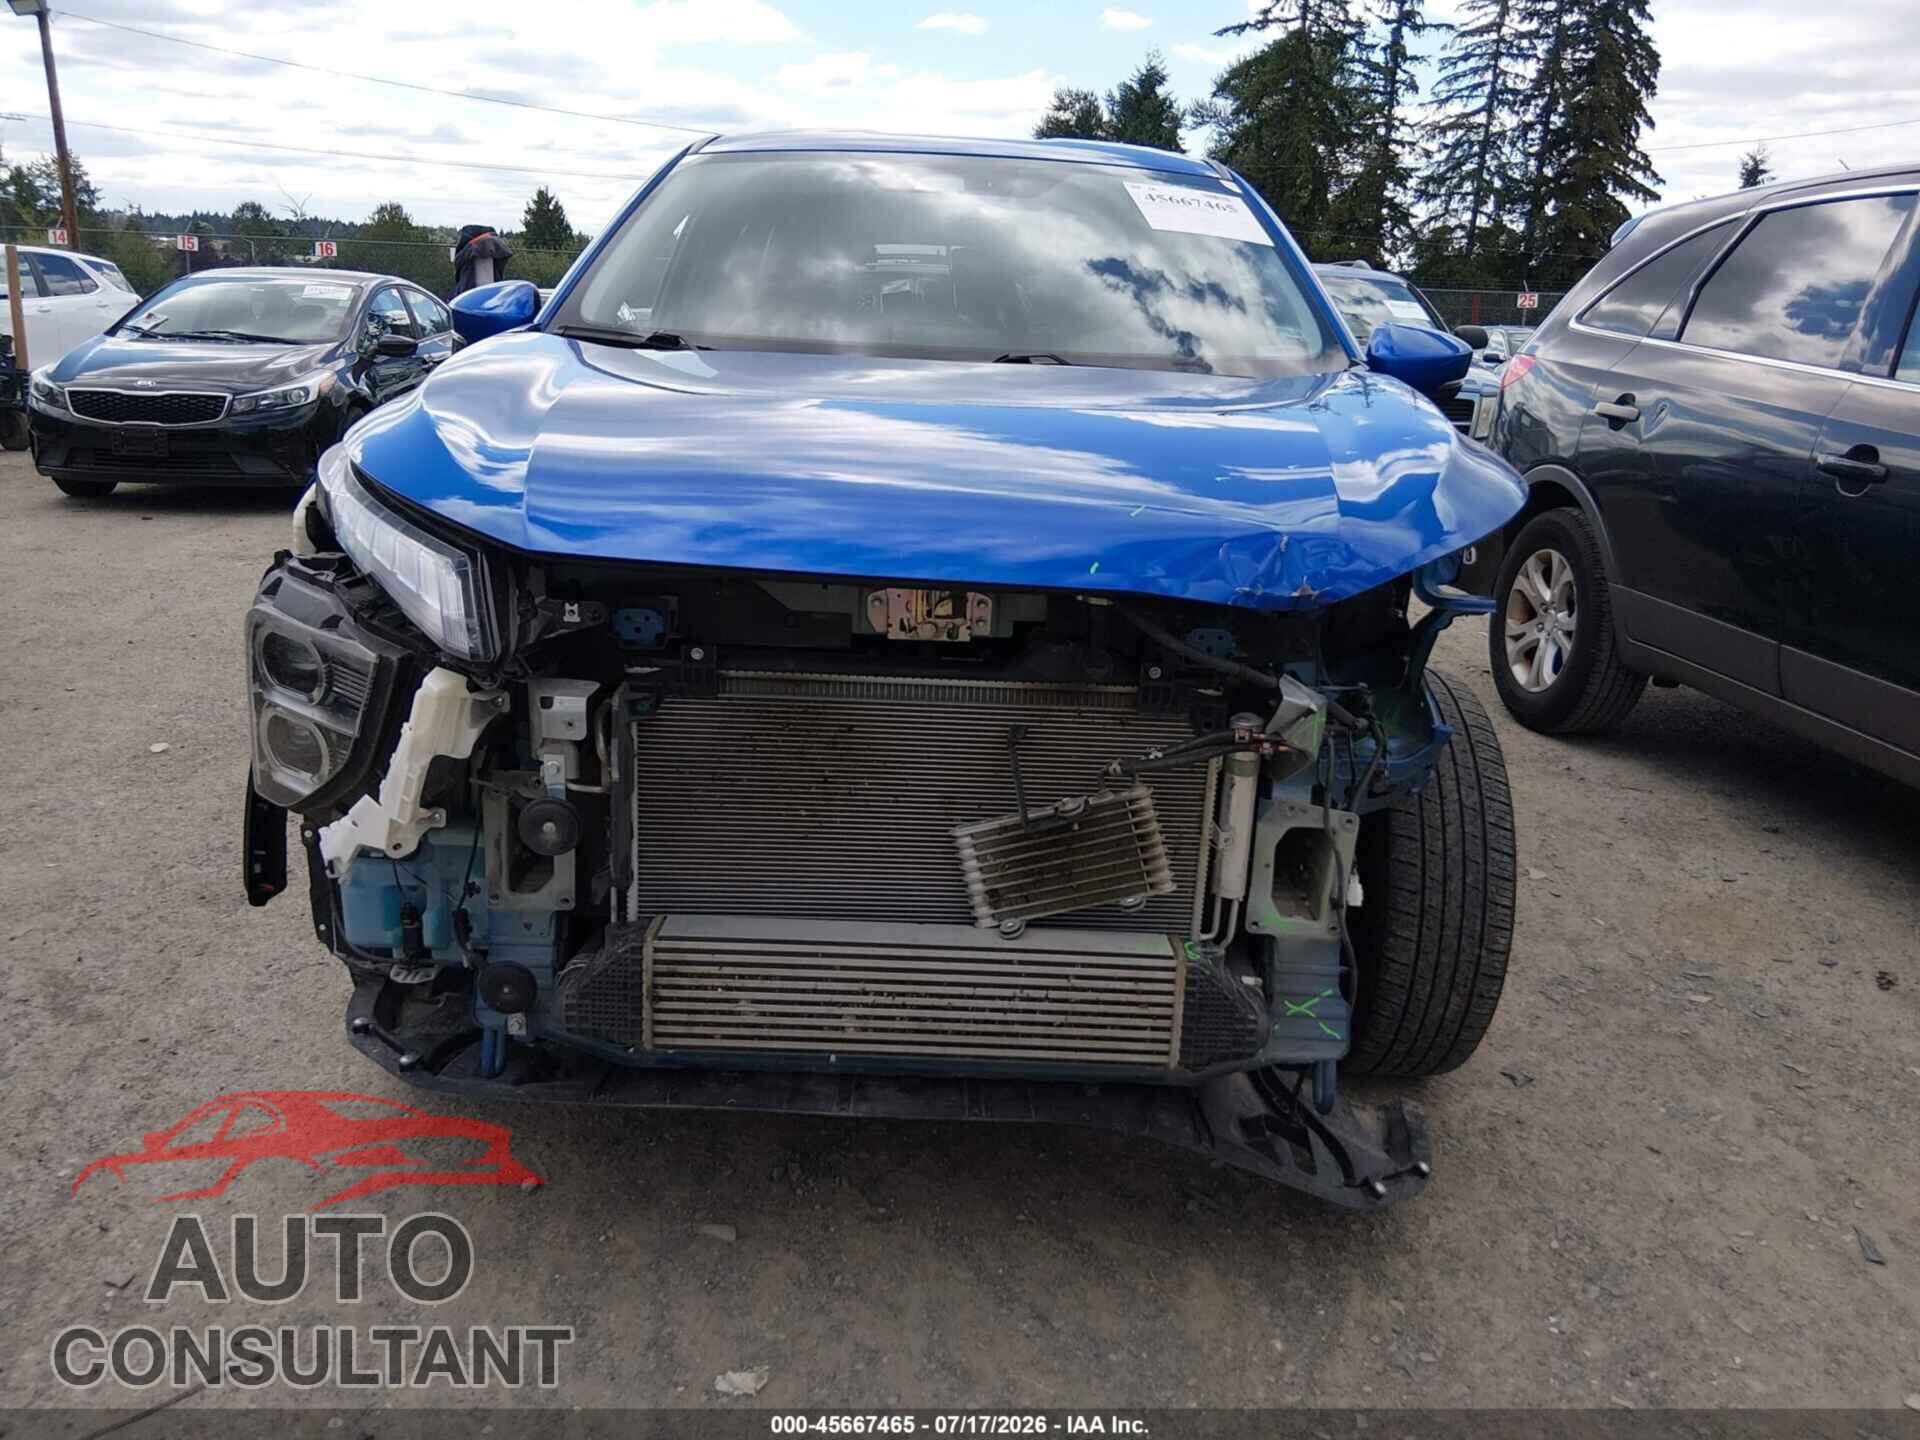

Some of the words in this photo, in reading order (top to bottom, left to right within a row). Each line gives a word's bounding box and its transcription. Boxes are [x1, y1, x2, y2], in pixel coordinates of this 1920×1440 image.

[1144, 192, 1238, 214] 45667465
[51, 231, 65, 244] 14
[181, 236, 195, 250] 15
[319, 242, 333, 256] 16
[1519, 294, 1536, 308] 25
